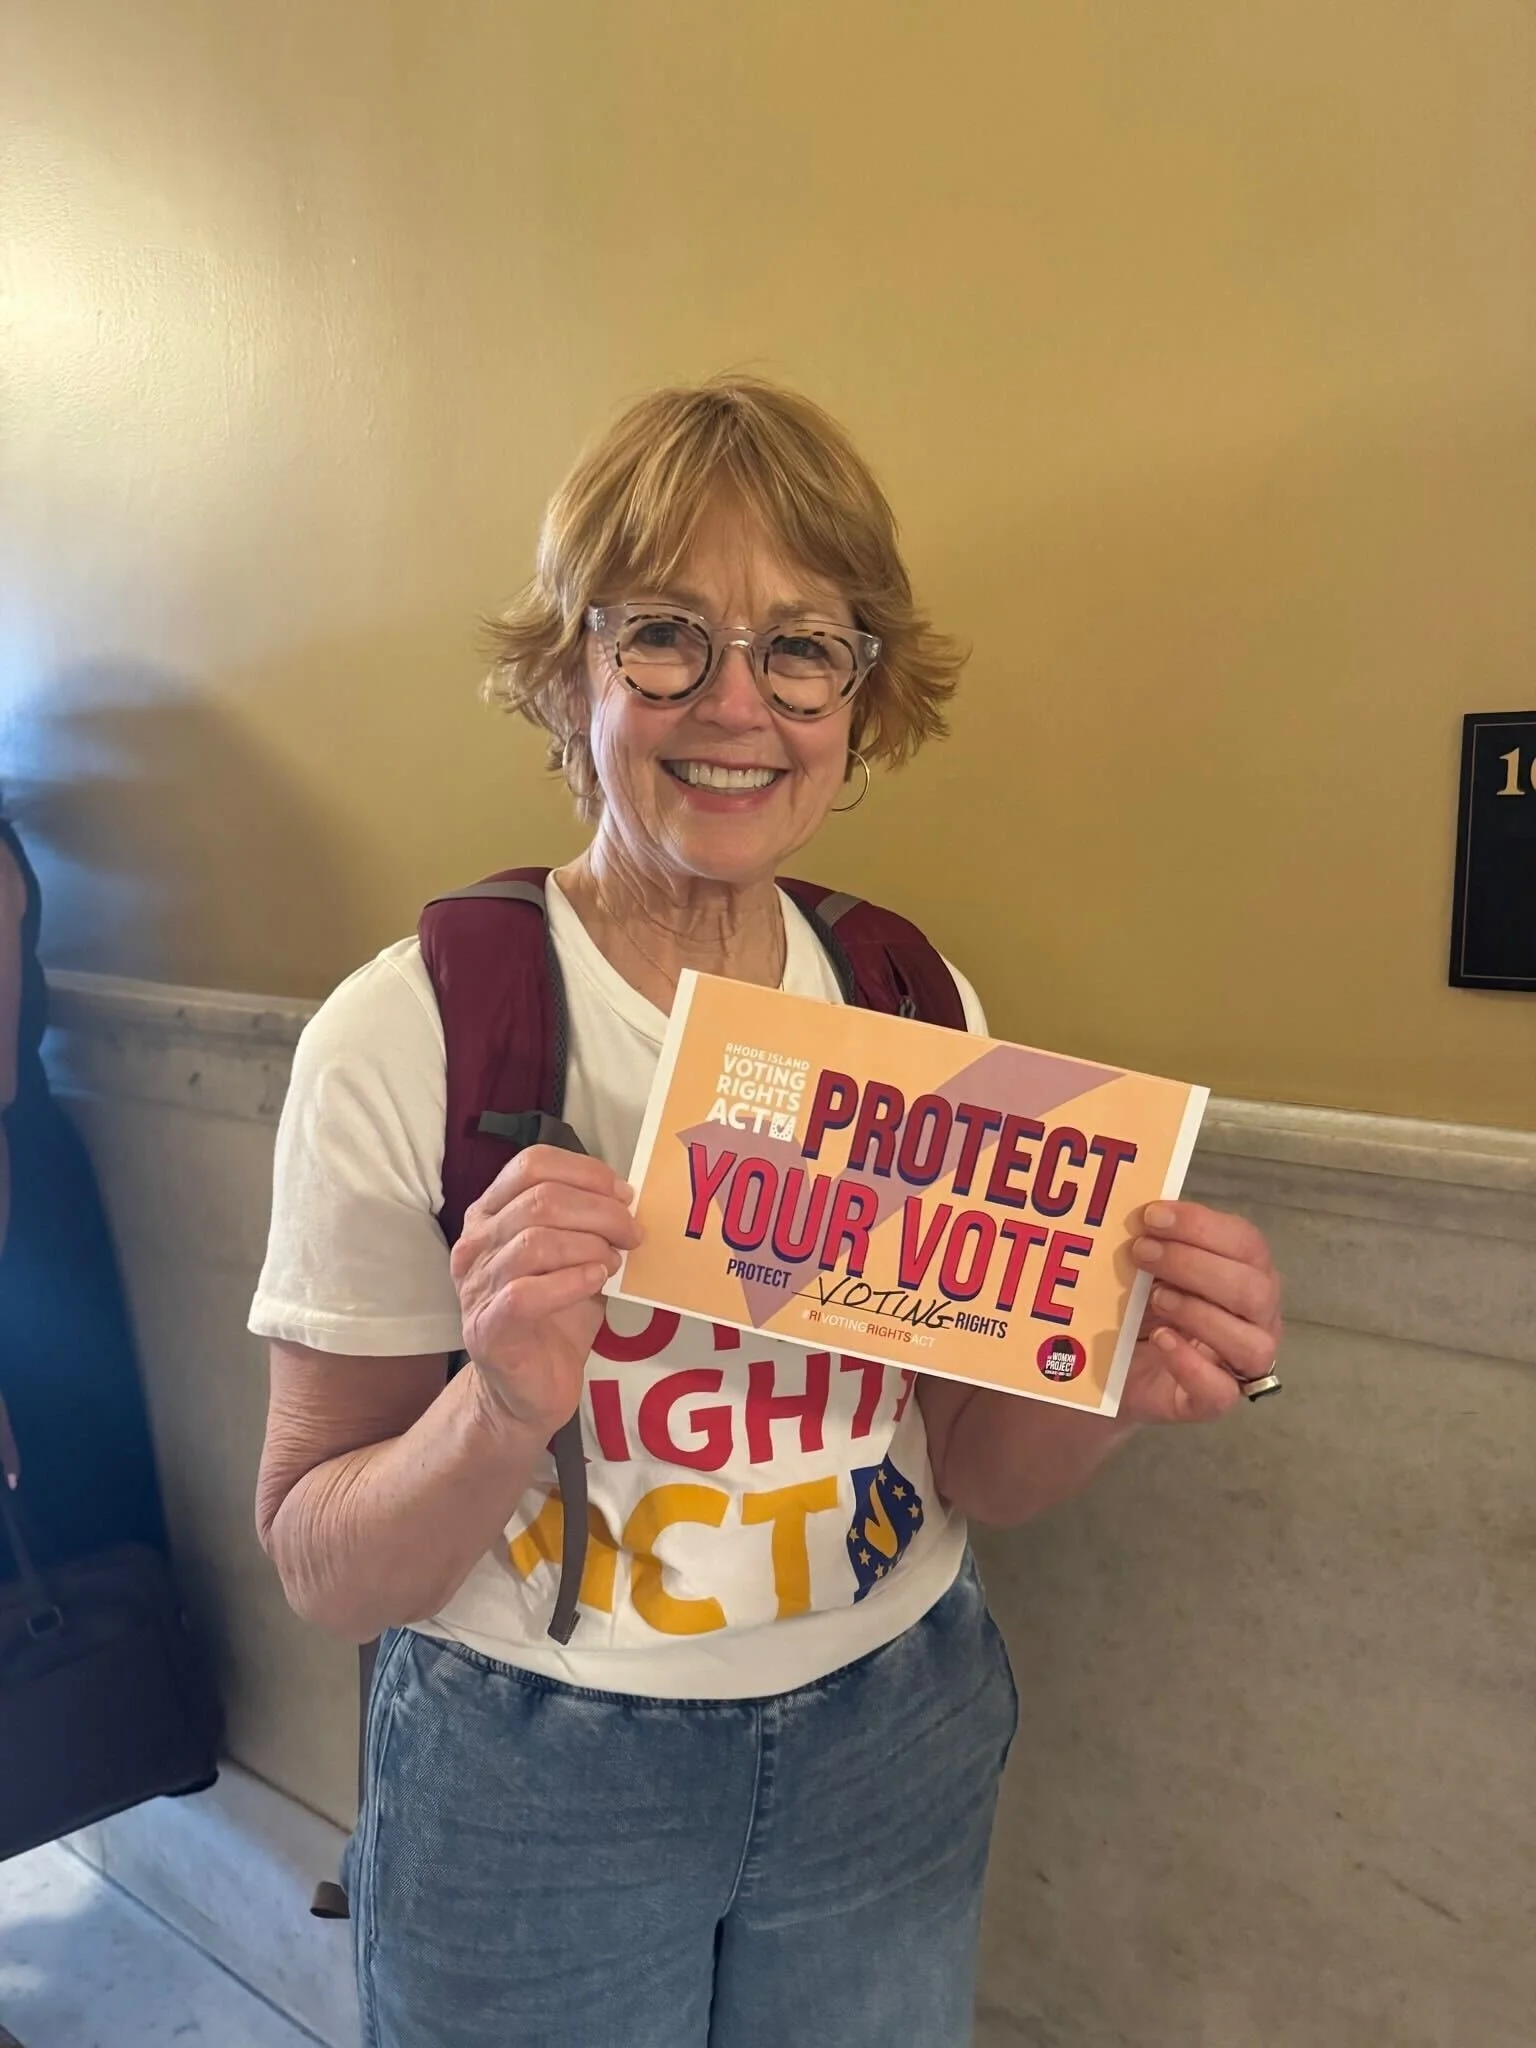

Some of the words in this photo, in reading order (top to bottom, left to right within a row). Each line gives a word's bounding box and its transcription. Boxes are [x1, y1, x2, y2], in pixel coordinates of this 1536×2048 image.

[723, 1054, 806, 1091] VOTING
[725, 1042, 766, 1061] RHODE
[767, 1052, 810, 1072] ISLAND
[716, 1074, 802, 1112] RIGHTS
[705, 1097, 771, 1134] ACT
[801, 1069, 1137, 1226] PROTECT
[685, 1143, 878, 1279] YOUR
[897, 1196, 1093, 1325] VOTE
[726, 1258, 792, 1289] PROTECT
[819, 1276, 953, 1329] VOTING
[801, 1309, 936, 1348] #RIVOTINGRIGHTSACT
[954, 1311, 1008, 1339] RIGHTS
[1045, 1359, 1075, 1373] PROJECT
[546, 1352, 918, 1473] IGHT
